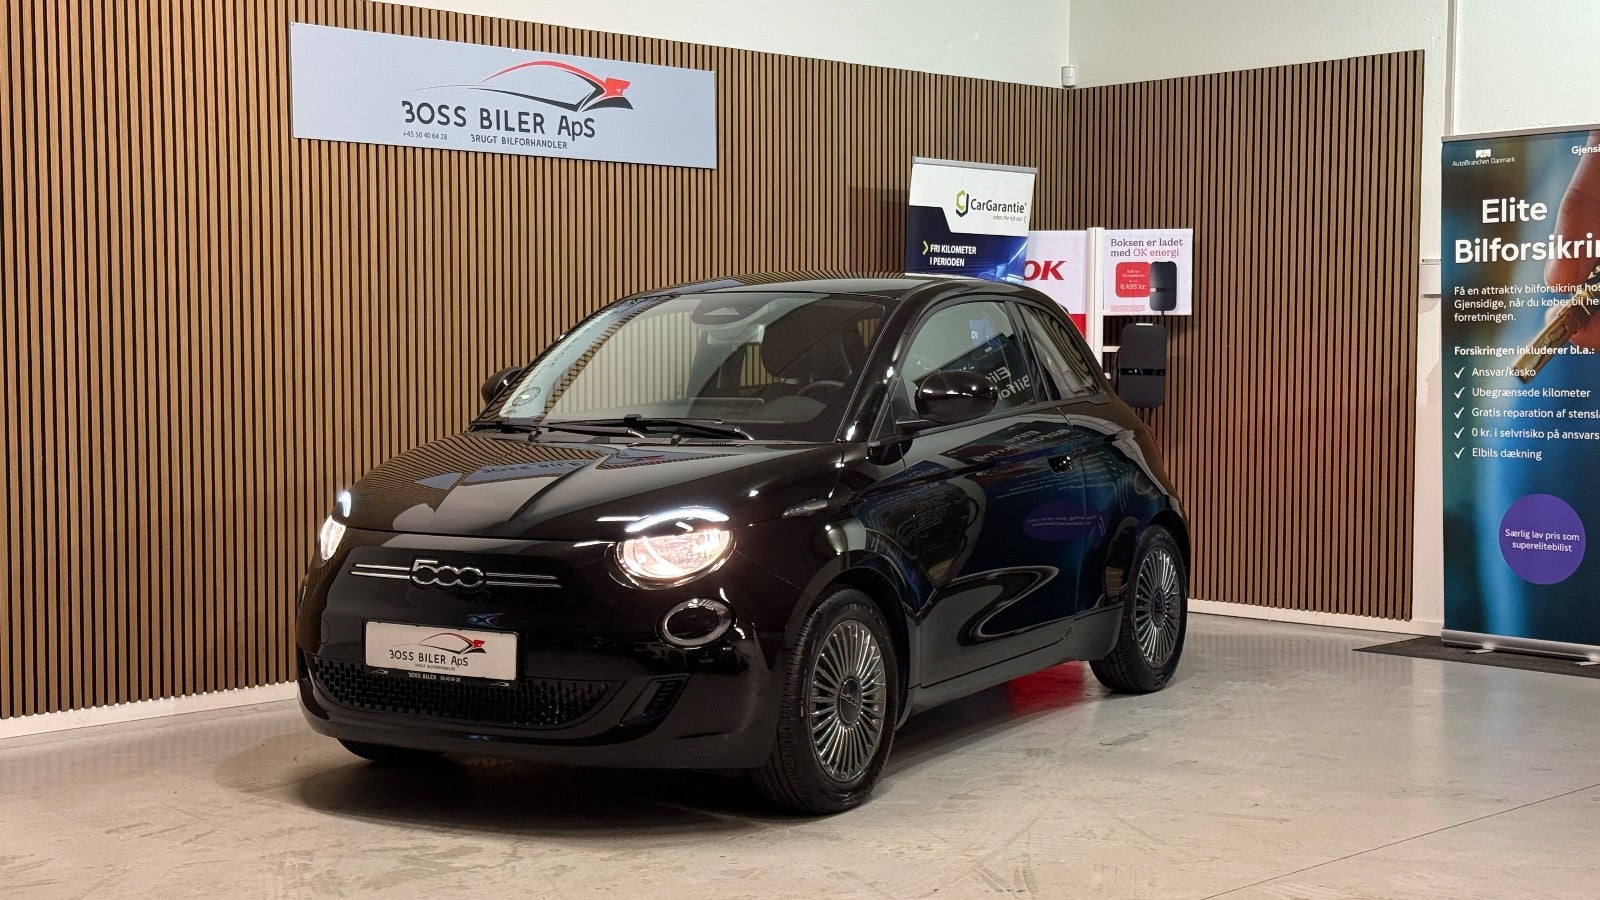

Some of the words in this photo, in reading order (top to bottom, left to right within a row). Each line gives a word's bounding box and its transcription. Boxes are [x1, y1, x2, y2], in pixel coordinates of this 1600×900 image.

[480, 108, 545, 134] BILER
[557, 115, 596, 142] ApS
[501, 136, 568, 149] BILFORHANDLER
[1491, 156, 1515, 164] Danmark
[1482, 196, 1548, 224] Elite
[1110, 238, 1144, 247] Boksen
[1159, 237, 1184, 247] ladet
[930, 244, 940, 253] FRI
[941, 244, 976, 255] KILOMETER
[1110, 249, 1131, 257] med
[1132, 248, 1148, 257] OK
[1150, 248, 1179, 258] energi
[933, 257, 965, 267] PERIODEN
[1024, 260, 1067, 281] OK
[1454, 285, 1465, 296] Få
[1467, 287, 1479, 295] en
[1481, 285, 1523, 295] attraktiv
[1525, 284, 1582, 295] bilforsikring
[1454, 299, 1507, 310] Gjensidige,
[1509, 298, 1524, 307] når
[1526, 298, 1539, 307] du
[1541, 298, 1569, 307] køber
[1571, 297, 1584, 306] bil
[1454, 312, 1516, 324] forretningen.
[1454, 346, 1515, 357] Forsikringen
[1517, 345, 1568, 355] inkluderer
[1570, 346, 1595, 355] bl.a.:
[1472, 367, 1536, 378] Ansvar/kasko
[1472, 388, 1540, 398] Ubegrænsede
[1542, 388, 1591, 398] kilometer
[1472, 408, 1501, 417] Gratis
[1503, 408, 1554, 419] reparation
[1556, 409, 1566, 418] af
[1568, 409, 1600, 419] stensl
[1471, 428, 1478, 437] 0
[1480, 428, 1492, 437] kr.
[1500, 428, 1544, 438] selvrisiko
[1547, 428, 1560, 440] på
[1562, 431, 1600, 440] ansvars
[1472, 448, 1498, 457] Elbils
[1500, 448, 1542, 461] dækning
[1505, 528, 1530, 540] Særlig
[1532, 530, 1544, 539] lav
[1545, 531, 1560, 541] pris
[1512, 542, 1573, 552] superelitebilist
[409, 558, 484, 588] 500
[418, 652, 446, 664] BILER
[451, 656, 469, 667] ApS
